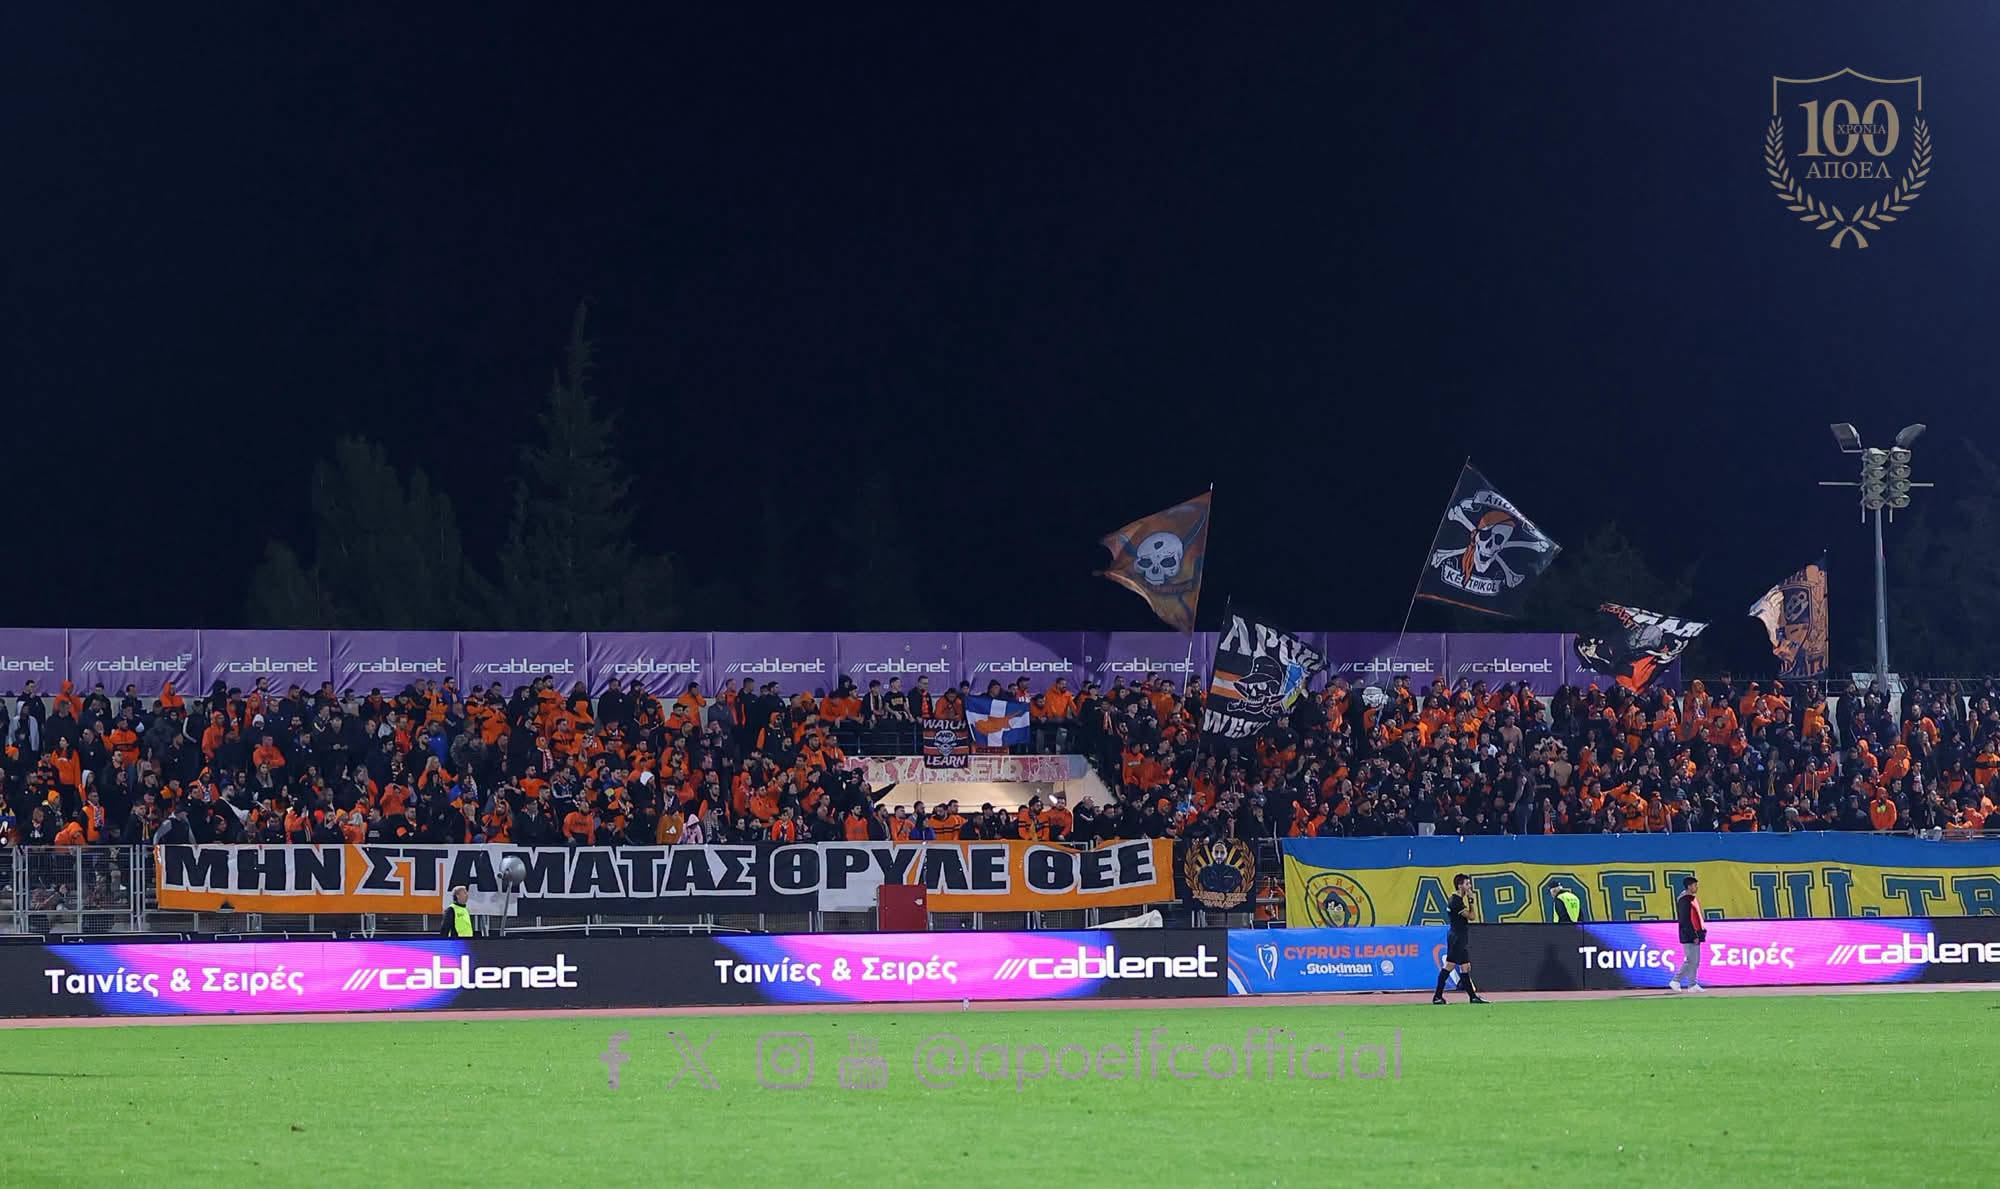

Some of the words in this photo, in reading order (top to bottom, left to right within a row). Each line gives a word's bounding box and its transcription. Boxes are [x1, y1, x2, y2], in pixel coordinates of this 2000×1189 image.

[1446, 570, 1498, 593] ΚΕΤΡΙΚΟΣ
[96, 656, 187, 672] cablenet
[228, 657, 318, 673] cablenet
[358, 657, 446, 673] cablenet
[487, 658, 574, 674] cablenet
[614, 658, 700, 673] cablenet
[740, 658, 825, 673] cablenet
[865, 658, 950, 673] cablenet
[989, 657, 1073, 672] cablenet
[1353, 657, 1434, 673] cablenet
[923, 719, 967, 730] WATCH
[926, 755, 966, 768] LEARN
[163, 845, 344, 892] ΜΗΝ
[1284, 945, 1350, 960] CYPRUS
[1355, 944, 1419, 958] LEAGUE
[1579, 943, 1675, 972] Ταινίες
[1710, 941, 1795, 970] Σειρές
[1029, 945, 1218, 979] cablenet
[1307, 962, 1373, 975] Stoiximan
[379, 954, 577, 990] cablenet
[714, 957, 821, 986] Ταινίες
[831, 960, 852, 982] &
[861, 956, 957, 985] Σειρές
[44, 966, 159, 998] Ταινίες
[170, 969, 192, 993] &
[201, 965, 304, 996] Σειρές
